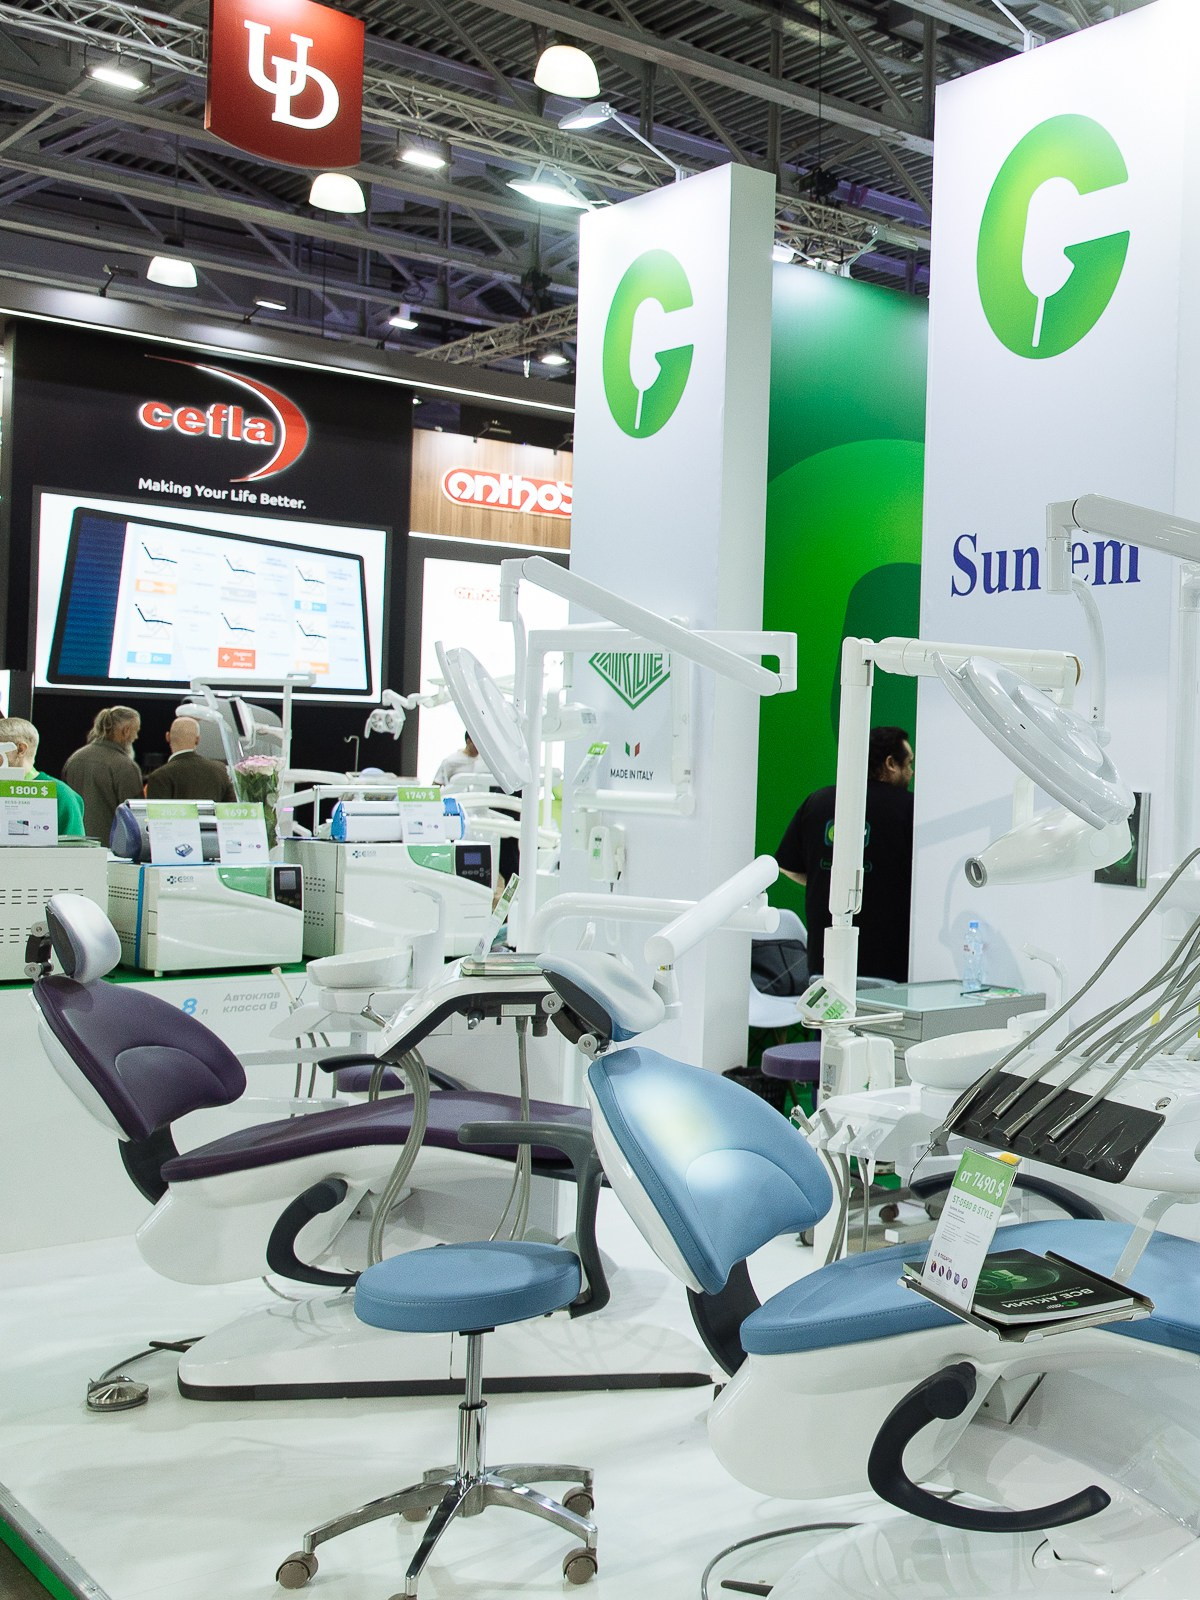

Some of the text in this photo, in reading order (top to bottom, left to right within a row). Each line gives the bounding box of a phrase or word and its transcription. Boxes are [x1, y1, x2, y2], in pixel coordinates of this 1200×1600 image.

[138, 401, 275, 445] cefla
[138, 477, 307, 509] Making Your Life Better.
[950, 533, 1141, 597] Sunem
[610, 768, 654, 780] MADE IN ITALY
[9, 785, 49, 797] 1800 $
[405, 791, 427, 800] 1749
[223, 991, 281, 1002] Автоклав
[182, 997, 198, 1015] 8
[222, 1003, 267, 1014] класса
[960, 1171, 1005, 1200] от 7490 $
[976, 1206, 994, 1220] STYLE
[1060, 1287, 1095, 1300] ВСЕ
[1001, 1294, 1058, 1309] АКЦИИ
